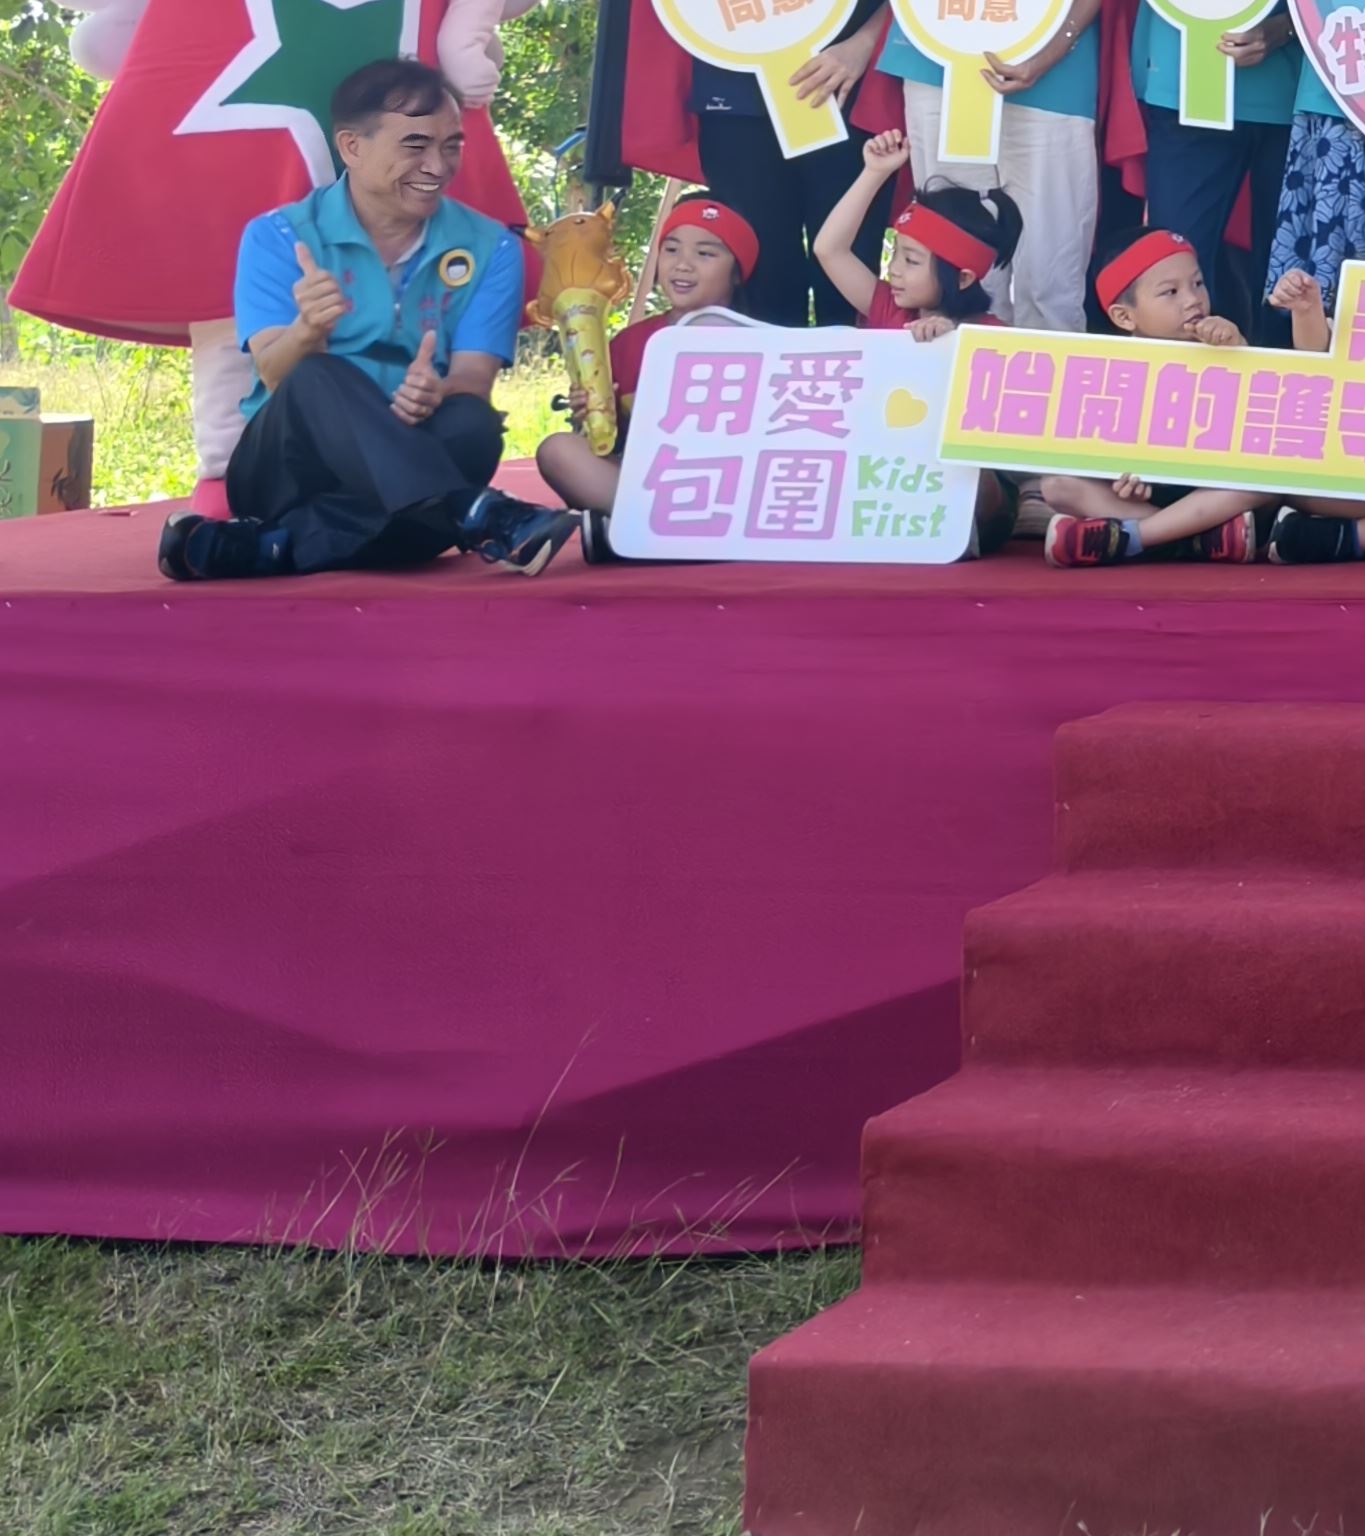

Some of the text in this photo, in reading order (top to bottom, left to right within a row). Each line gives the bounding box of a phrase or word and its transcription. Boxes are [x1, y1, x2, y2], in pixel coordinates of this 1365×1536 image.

[657, 349, 864, 438] 用愛
[643, 444, 847, 540] 包圍
[856, 454, 944, 494] Kids
[851, 499, 948, 538] First
